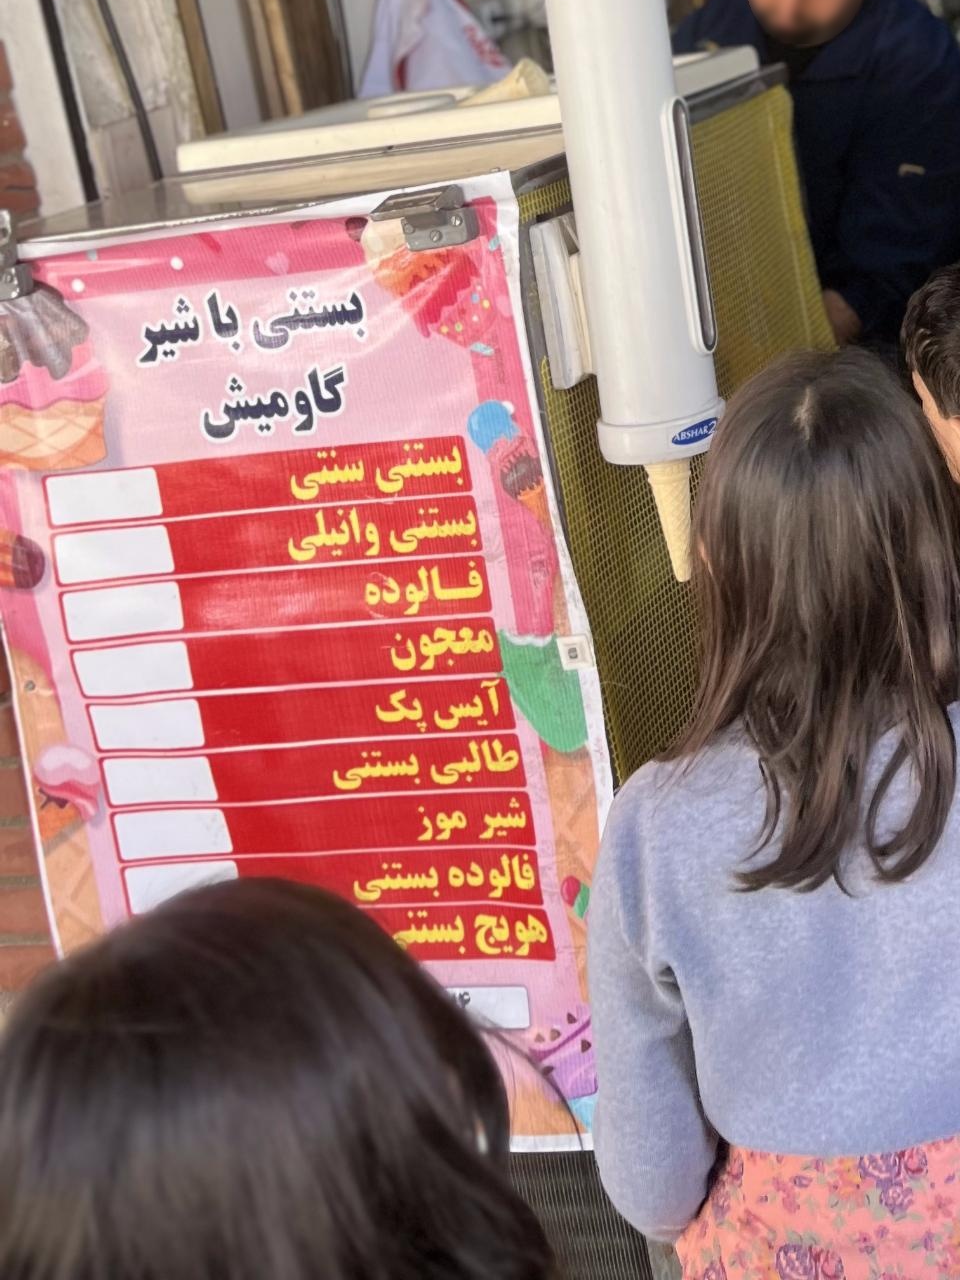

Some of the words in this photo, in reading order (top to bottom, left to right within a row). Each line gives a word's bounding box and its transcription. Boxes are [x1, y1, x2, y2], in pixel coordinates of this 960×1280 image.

[139, 297, 200, 362] شیر
[206, 291, 241, 351] با
[253, 290, 365, 349] بستنی
[203, 366, 346, 439] گاومیش
[674, 425, 709, 441] ABSHAR
[290, 449, 365, 500] سنتی
[375, 442, 464, 493] بستنی
[288, 505, 381, 561] وانیلی
[389, 506, 478, 554] بستنی
[390, 626, 496, 671] معجون
[375, 689, 424, 733] پک
[433, 679, 500, 730] آیس
[333, 751, 420, 790] بستنی
[430, 738, 520, 784] طالبی
[418, 805, 467, 841] موز
[478, 797, 527, 839] شیر
[353, 862, 439, 901] بستنی
[448, 853, 536, 898] فالوده
[474, 913, 548, 956] هویج
